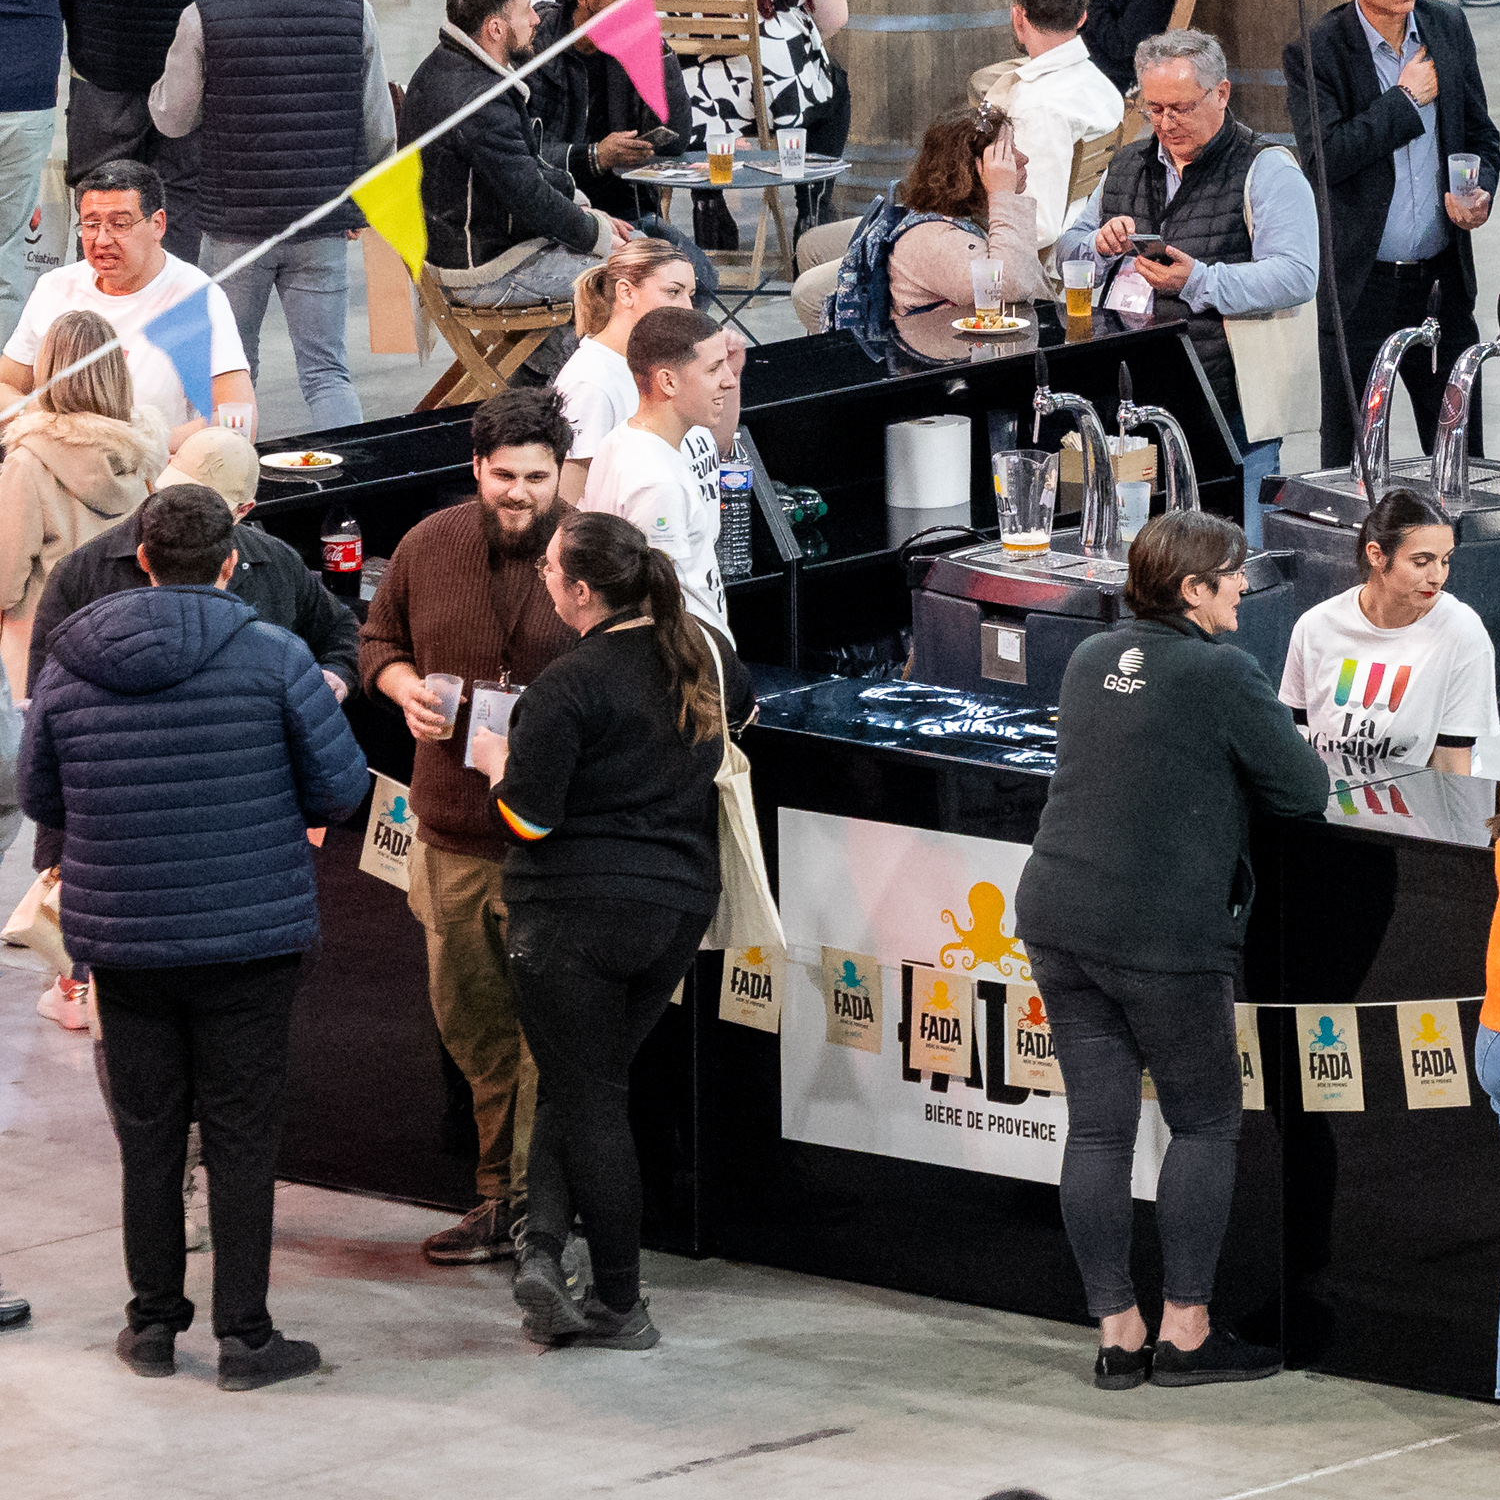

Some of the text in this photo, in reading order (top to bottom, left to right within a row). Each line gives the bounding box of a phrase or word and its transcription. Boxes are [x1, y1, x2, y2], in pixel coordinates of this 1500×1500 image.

[685, 435, 710, 460] La
[998, 496, 1012, 513] DA
[1103, 673, 1147, 695] GSF
[1341, 712, 1376, 740] La
[373, 820, 412, 857] FADA
[730, 966, 773, 1002] FADA
[833, 988, 874, 1023] FADA
[919, 1012, 963, 1046] FADA
[1016, 1028, 1058, 1060] FADA
[1308, 1052, 1354, 1081] FADA
[1411, 1047, 1458, 1078] FADA
[925, 1100, 1058, 1143] BIÈRE DE PROVENCE
